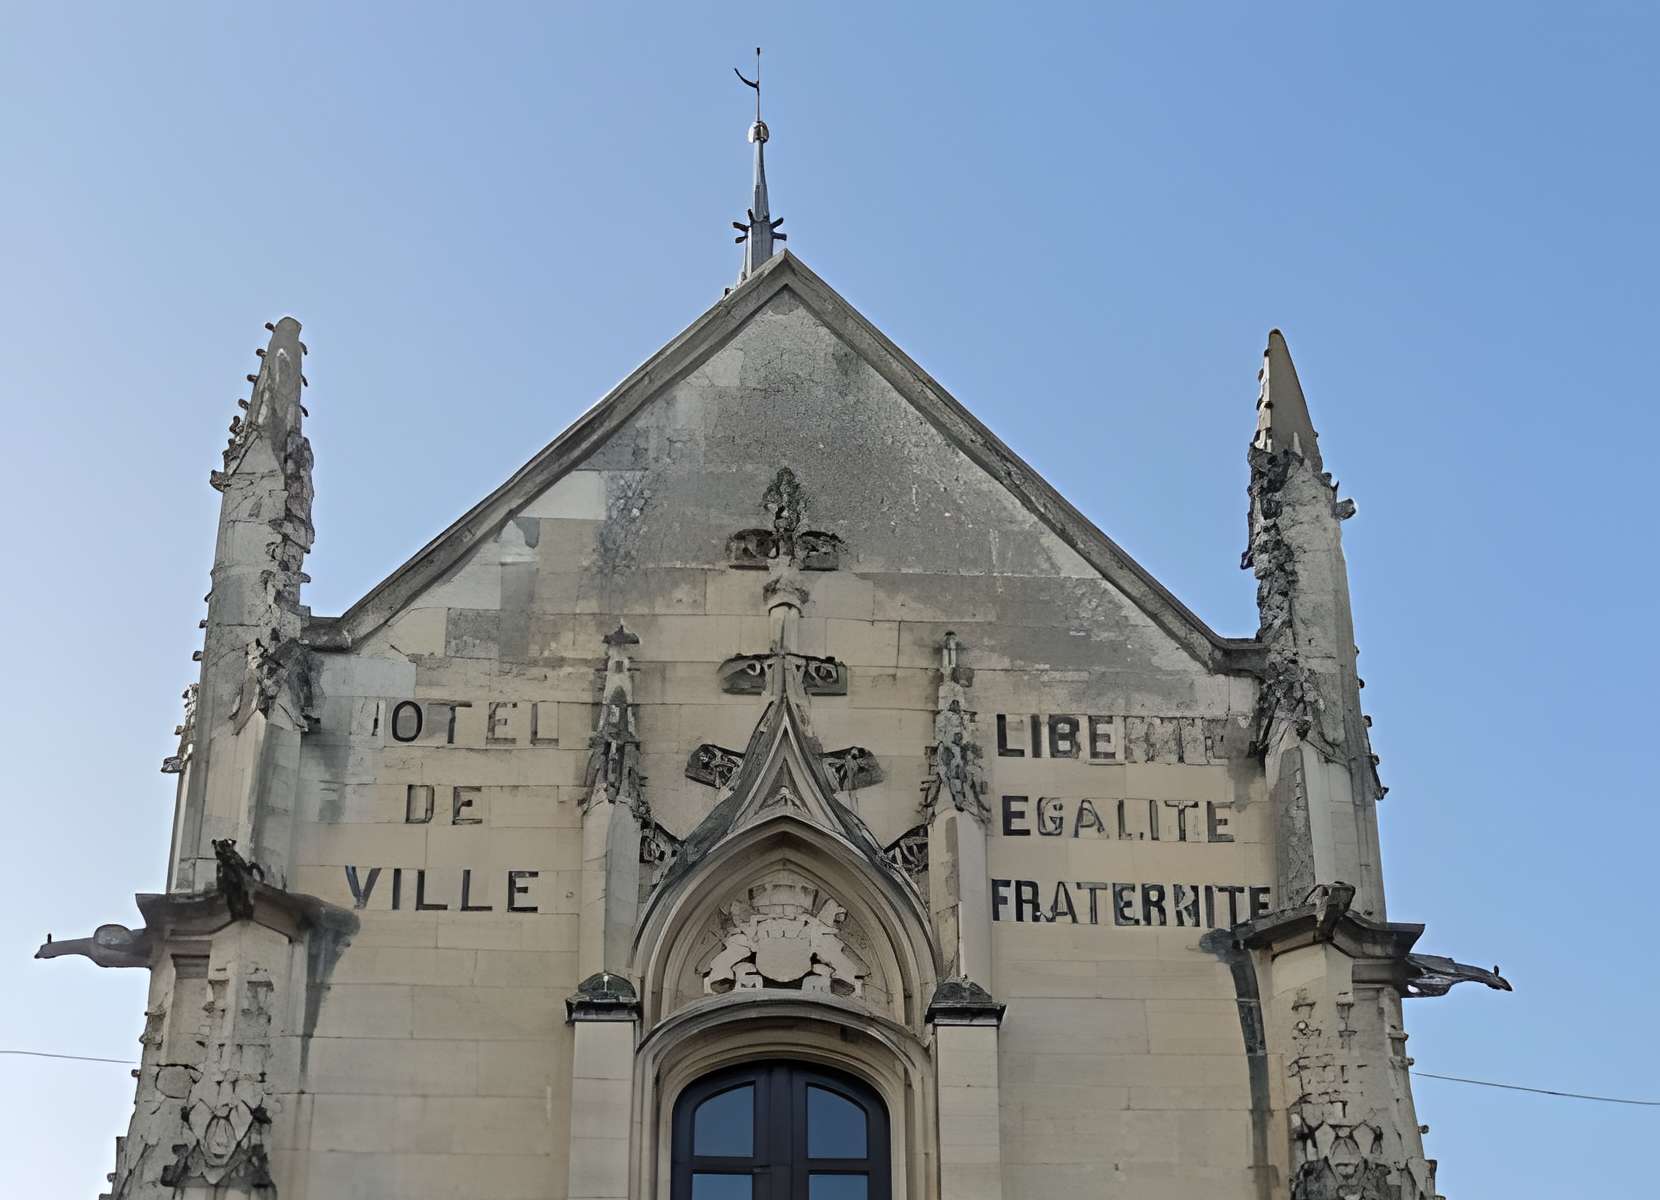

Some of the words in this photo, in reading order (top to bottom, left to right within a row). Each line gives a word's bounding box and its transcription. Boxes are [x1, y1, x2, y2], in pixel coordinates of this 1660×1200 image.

[350, 700, 559, 746] OTEL
[404, 784, 483, 826] DE
[1001, 795, 1235, 843] EGALITE
[345, 864, 539, 913] VILLE
[991, 878, 1271, 930] FRATERNITE
